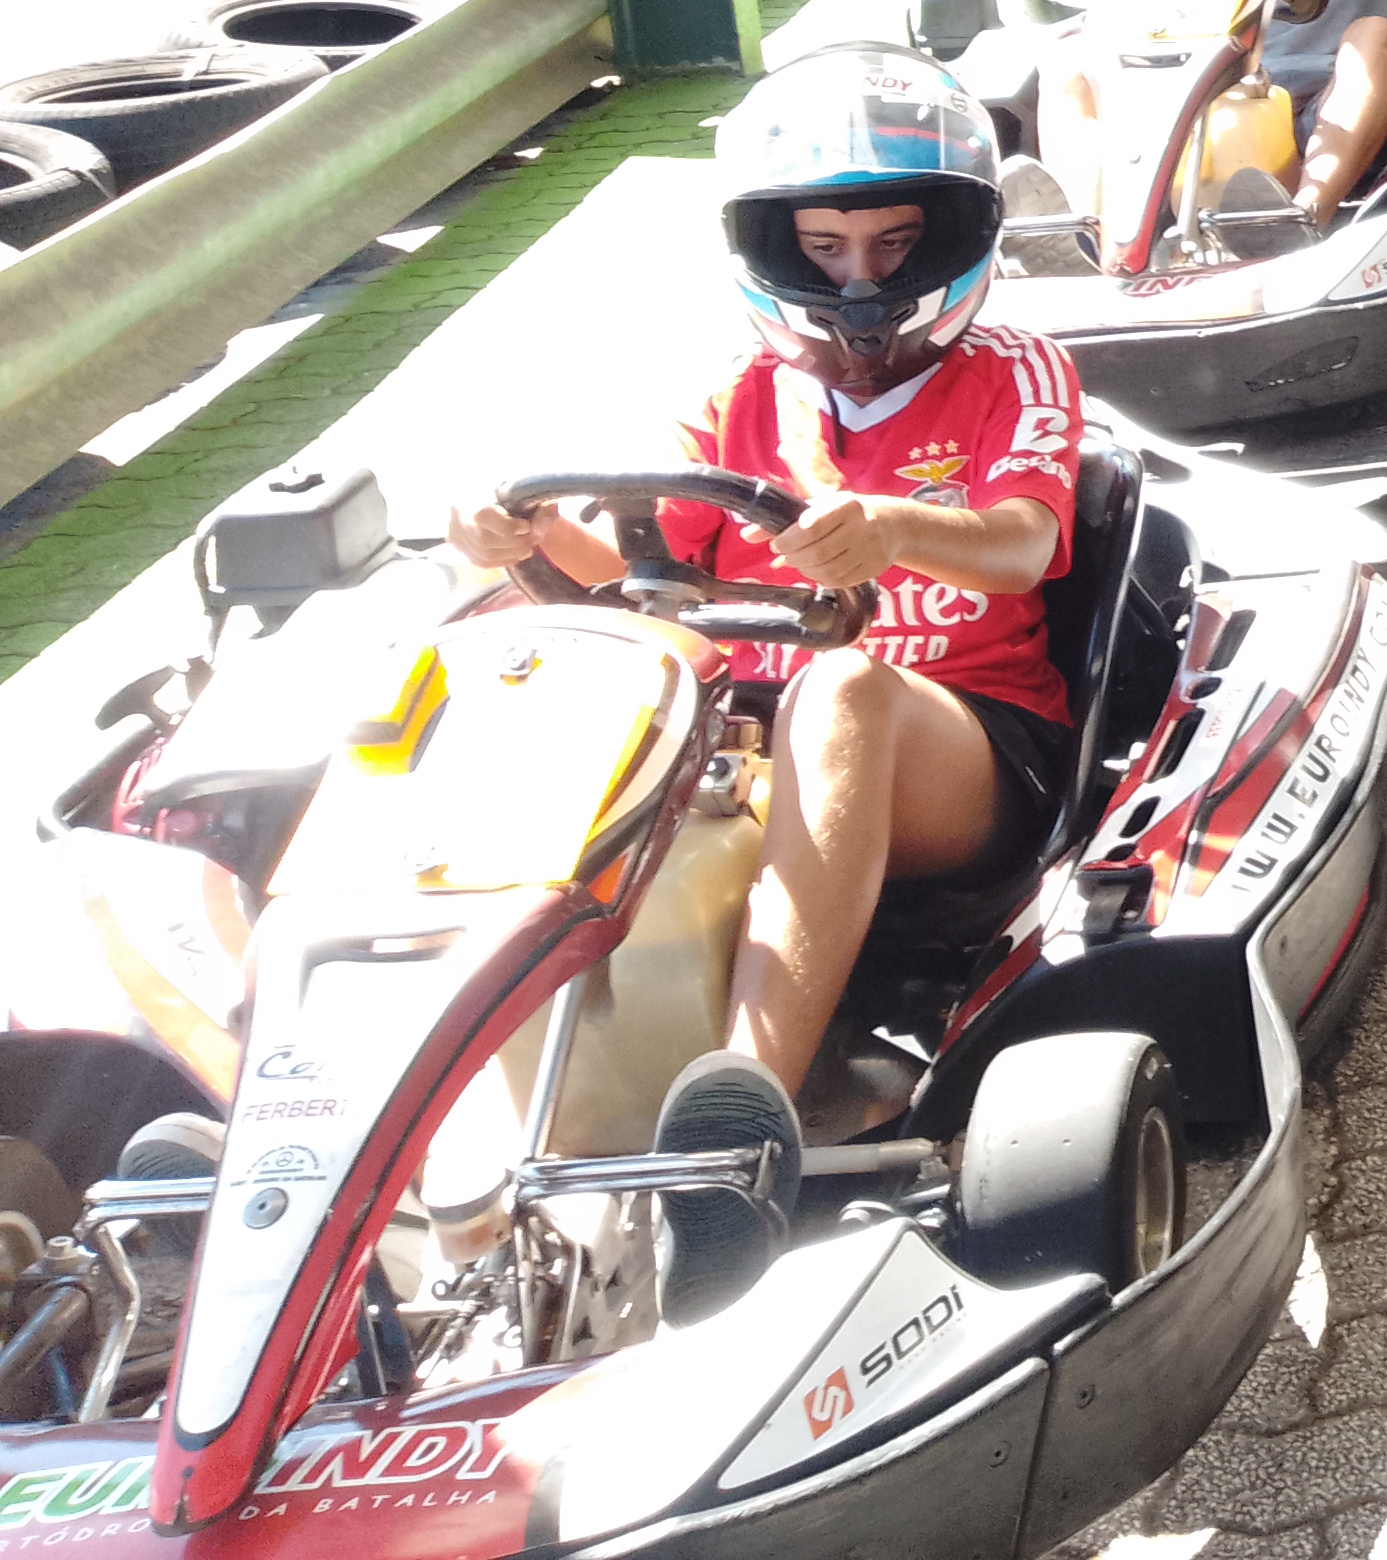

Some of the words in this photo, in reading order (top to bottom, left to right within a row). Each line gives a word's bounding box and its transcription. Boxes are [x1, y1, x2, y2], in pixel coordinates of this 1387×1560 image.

[241, 1098, 348, 1123] FERBER
[858, 1283, 965, 1389] SODI
[238, 1502, 288, 1523] DA
[311, 1488, 497, 1516] BATALHA
